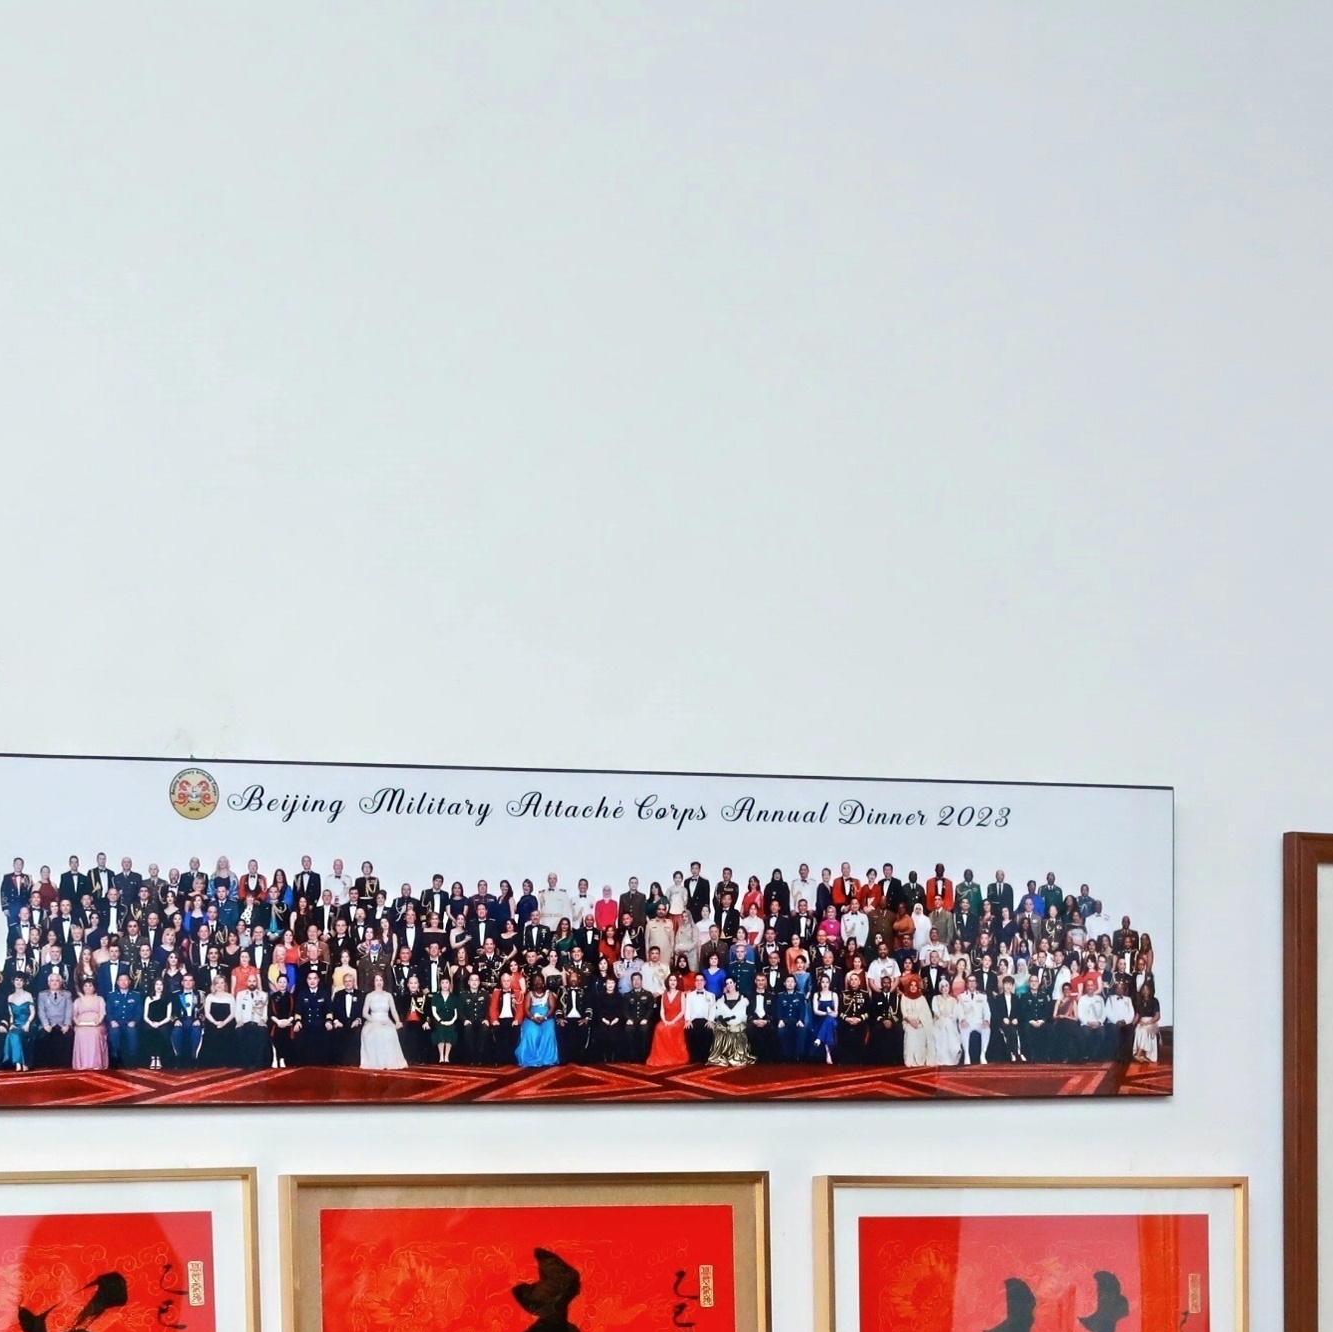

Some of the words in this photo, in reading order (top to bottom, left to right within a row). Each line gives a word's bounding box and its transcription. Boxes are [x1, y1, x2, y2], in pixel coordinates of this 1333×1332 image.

[226, 785, 346, 824] Beijing
[359, 787, 493, 827] Military
[634, 794, 709, 830] Corps
[720, 795, 829, 825] Annual
[838, 800, 928, 828] Dinner
[937, 805, 1012, 828] 2023
